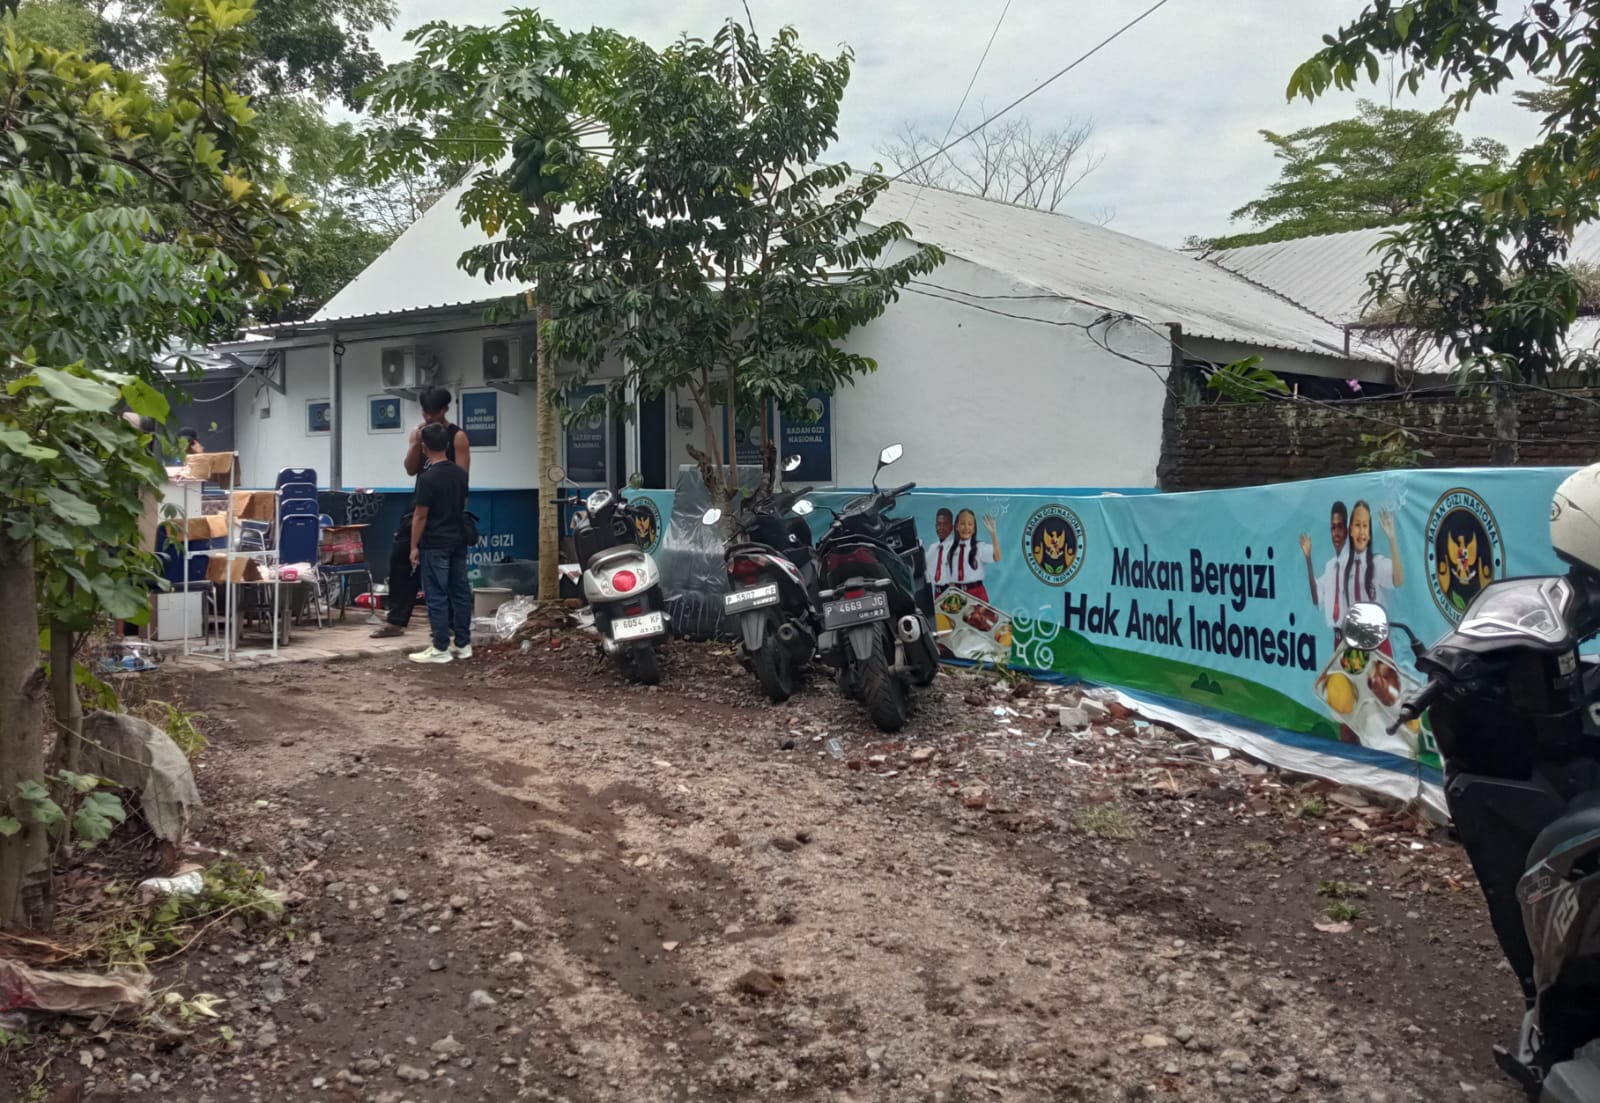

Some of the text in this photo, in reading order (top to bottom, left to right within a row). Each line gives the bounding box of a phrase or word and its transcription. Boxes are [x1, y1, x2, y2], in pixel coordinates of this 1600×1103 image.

[788, 435, 823, 443] NASIONAL
[491, 534, 514, 547] GIZI
[1057, 507, 1083, 537] NASIONAL
[1428, 494, 1500, 549] BADAN GIZI NASIONAL
[1111, 544, 1276, 612] Makan Bergizi
[1431, 572, 1462, 622] REPUBLIK
[839, 600, 862, 613] 4669
[1064, 592, 1317, 671] Hak Anak Indonesia
[1552, 887, 1580, 943] 125
